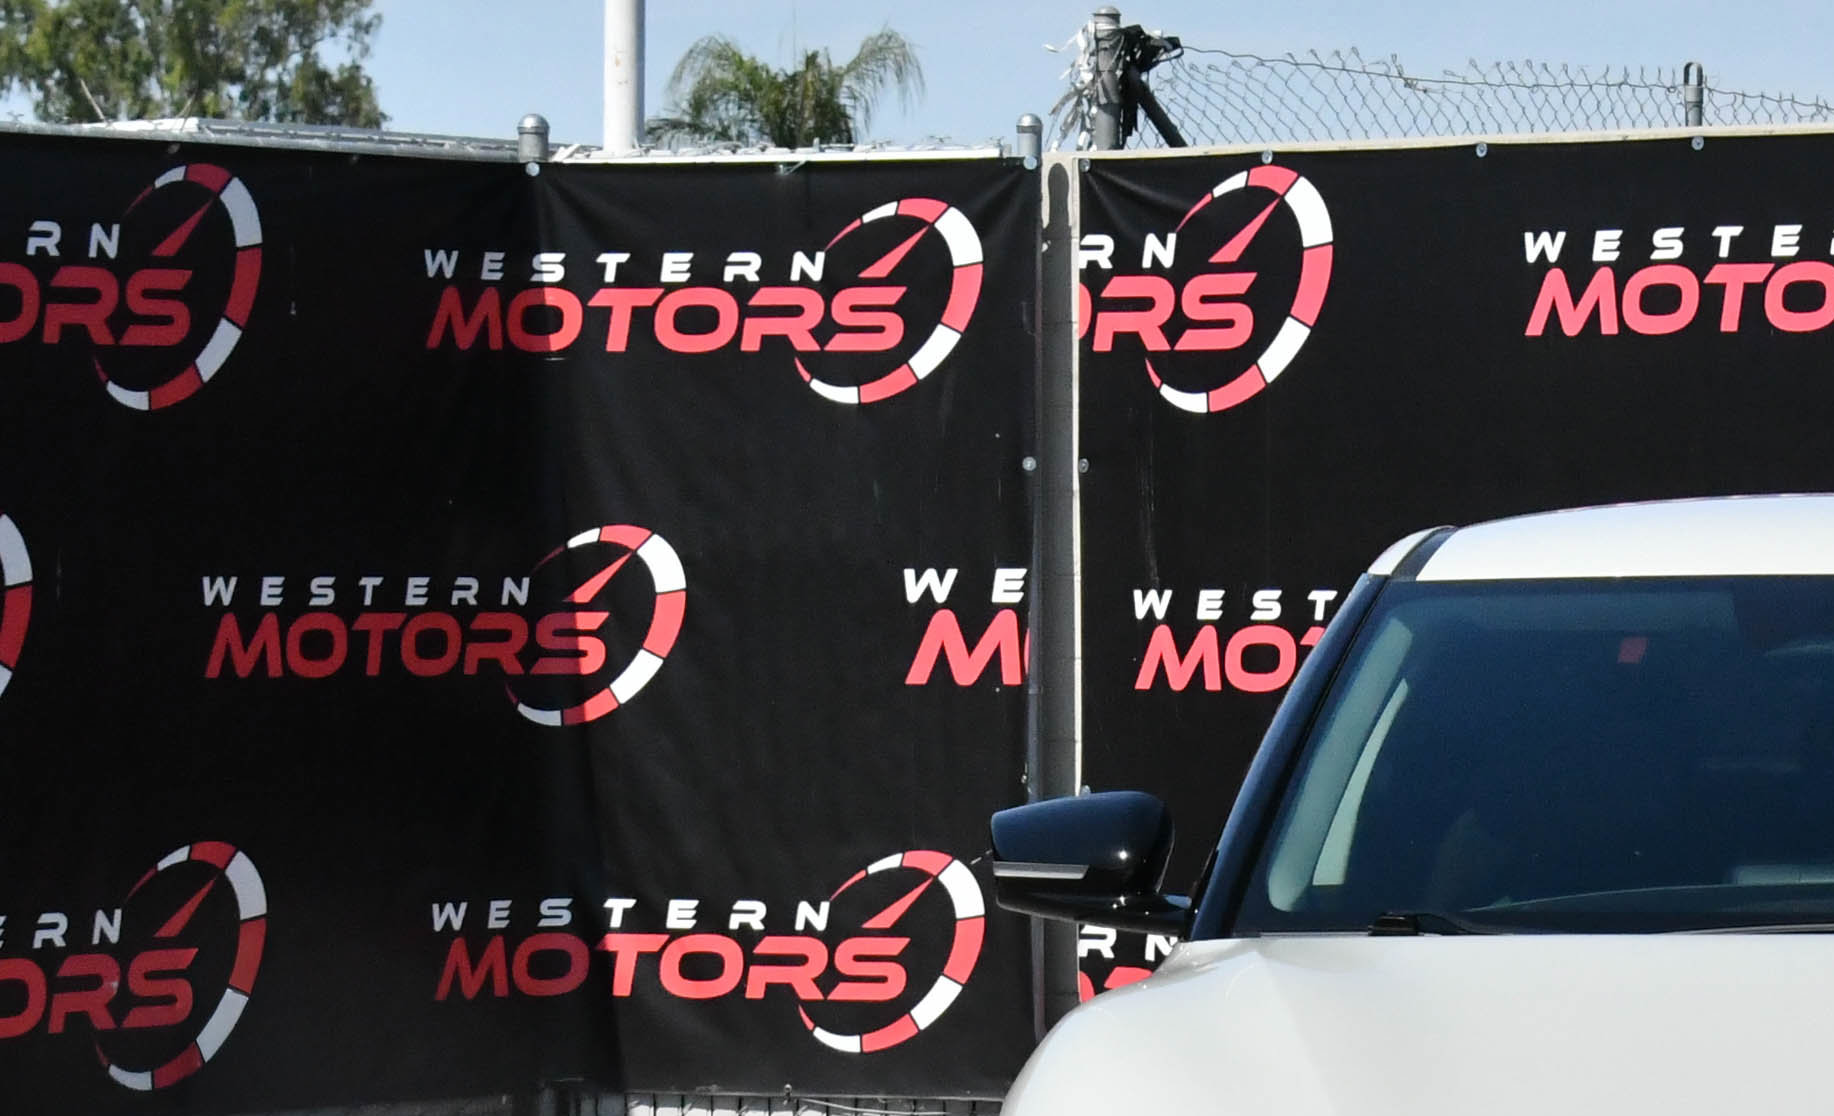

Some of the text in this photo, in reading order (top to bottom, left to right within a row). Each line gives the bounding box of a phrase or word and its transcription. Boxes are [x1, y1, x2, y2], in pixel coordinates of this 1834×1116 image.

[424, 249, 826, 284] WESTERN
[427, 284, 909, 355] MOTORS
[1079, 270, 1259, 353] RS
[202, 576, 530, 606] WESTERN
[903, 567, 1028, 604] WE
[1132, 588, 1338, 621] WEST
[205, 609, 611, 679] MOTORS
[904, 607, 1031, 687] M
[1133, 622, 1327, 695] MO
[0, 908, 123, 950] RN
[432, 897, 831, 932] WESTERN
[436, 931, 912, 1004] MOTORS
